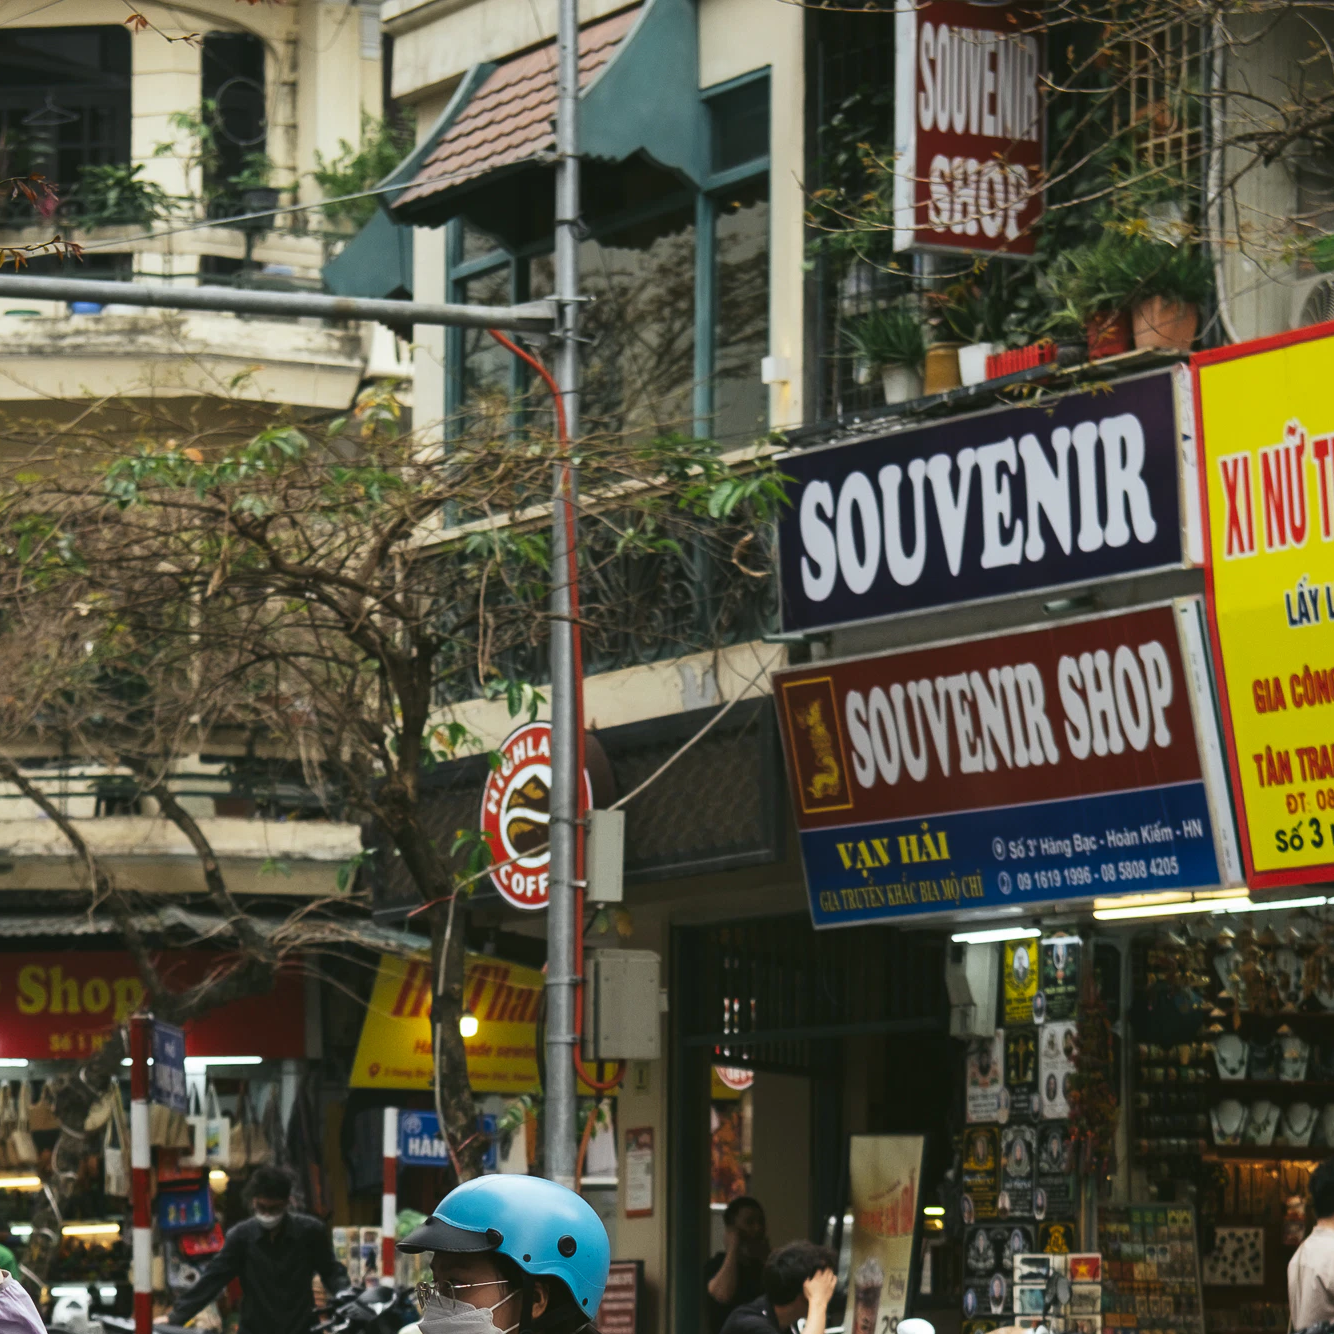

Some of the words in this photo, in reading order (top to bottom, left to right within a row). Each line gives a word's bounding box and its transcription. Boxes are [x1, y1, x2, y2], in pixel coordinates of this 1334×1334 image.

[918, 21, 1039, 142] SOUVENIR
[928, 154, 1029, 241] SHOP
[800, 413, 1157, 602] SOUVENIR
[1219, 456, 1256, 557] XI
[1261, 420, 1308, 549] NỮ
[1284, 573, 1322, 627] LẤY
[845, 662, 1060, 789] SOUVENIR
[1057, 640, 1174, 760] SHOP
[1252, 676, 1287, 715] GIA
[1253, 744, 1293, 788] TÂN
[1285, 794, 1312, 816] ĐT:
[836, 839, 891, 878] VẠN
[897, 821, 951, 864] HẢI
[1008, 837, 1026, 860] Số
[1040, 837, 1072, 858] Hàng
[1072, 832, 1097, 856] Bạc
[1105, 827, 1139, 848] Hoàn
[1140, 819, 1173, 845] Kiếm
[1182, 818, 1203, 839] HN
[1274, 820, 1308, 855] Số
[1310, 816, 1325, 849] 3
[499, 864, 550, 898] COFF
[919, 880, 938, 902] BIA
[1017, 871, 1032, 891] 09
[1033, 868, 1062, 890] 1619
[1065, 865, 1092, 887] 1996
[1101, 863, 1117, 883] 08
[1118, 859, 1148, 880] 5808
[1149, 855, 1179, 876] 4205
[17, 965, 144, 1025] Shop
[408, 1131, 447, 1158] HÀN
